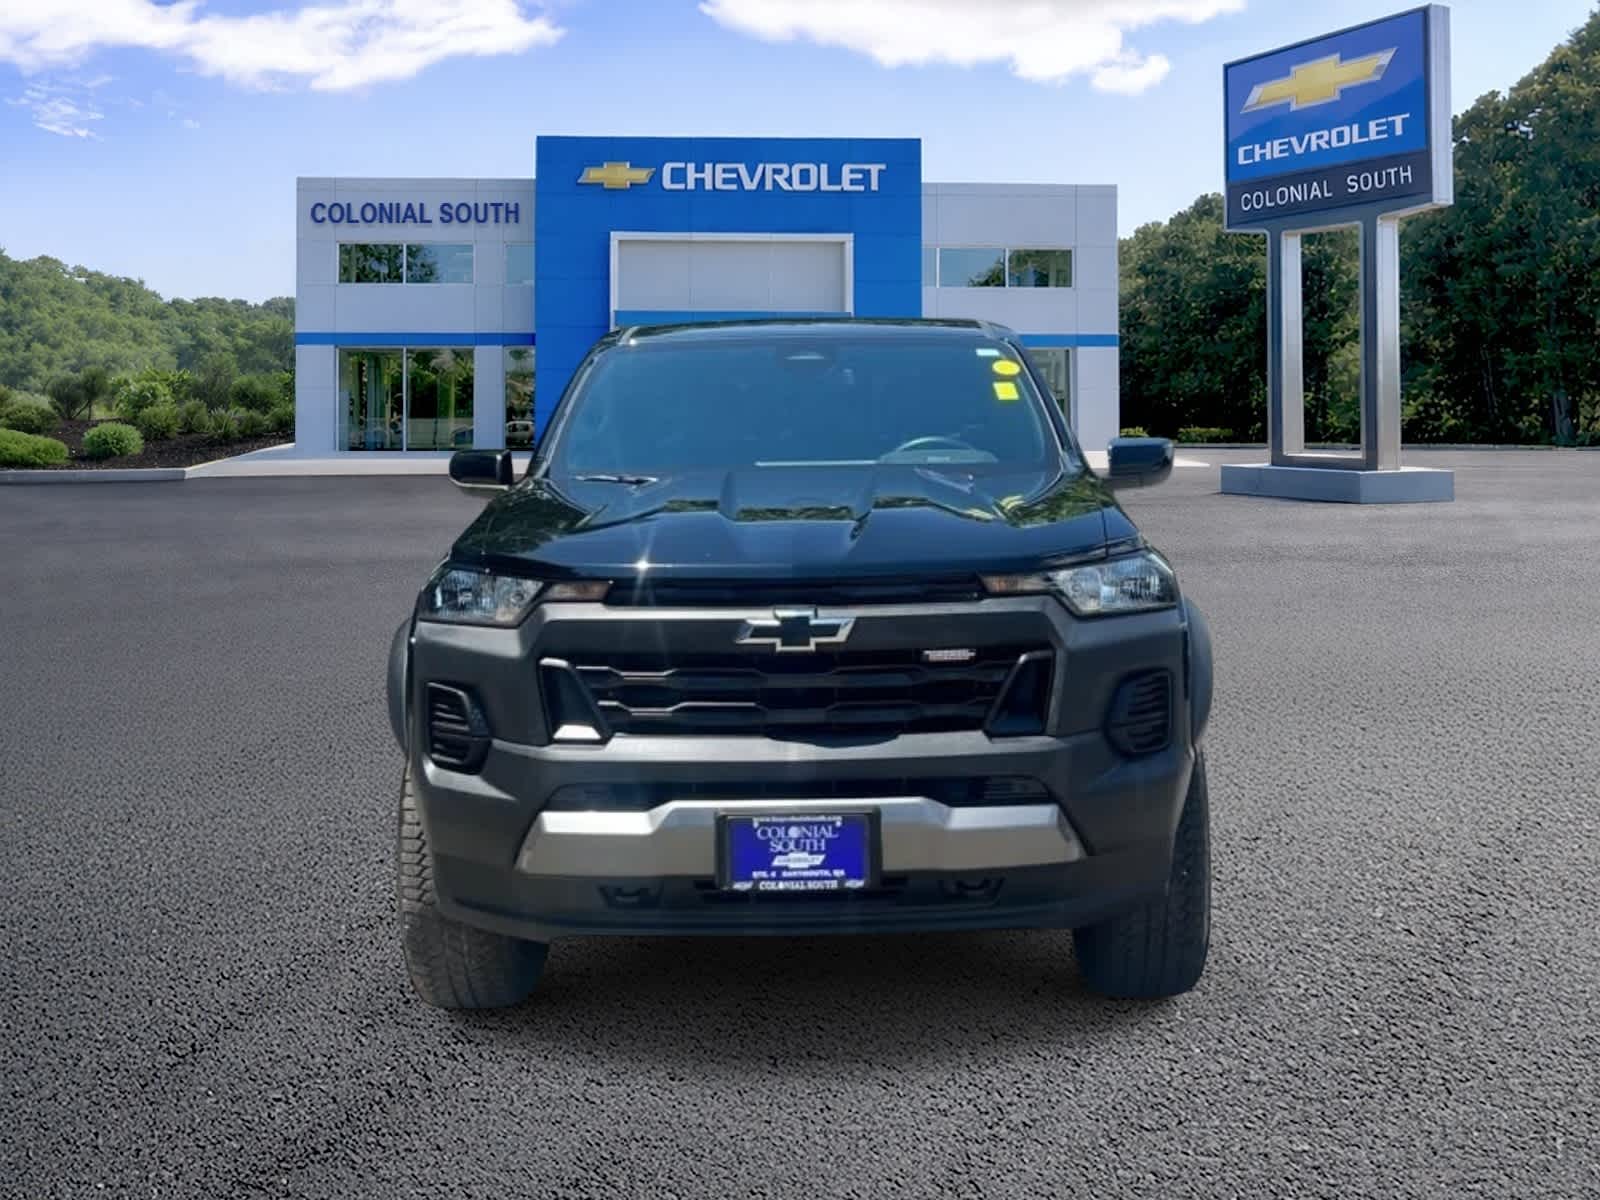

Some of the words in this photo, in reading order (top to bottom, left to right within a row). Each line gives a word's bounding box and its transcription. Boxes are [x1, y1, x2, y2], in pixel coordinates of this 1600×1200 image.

[1237, 112, 1410, 165] CHEVROLET
[661, 161, 887, 191] CHEVROLET
[1240, 179, 1333, 211] COLONIAL
[1346, 165, 1413, 194] SOUTH
[310, 202, 433, 224] COLONIAL
[439, 202, 520, 224] SOUTH
[757, 826, 839, 839] COLONIAL
[769, 839, 826, 852] SOUTH
[759, 880, 806, 890] COLONIAL
